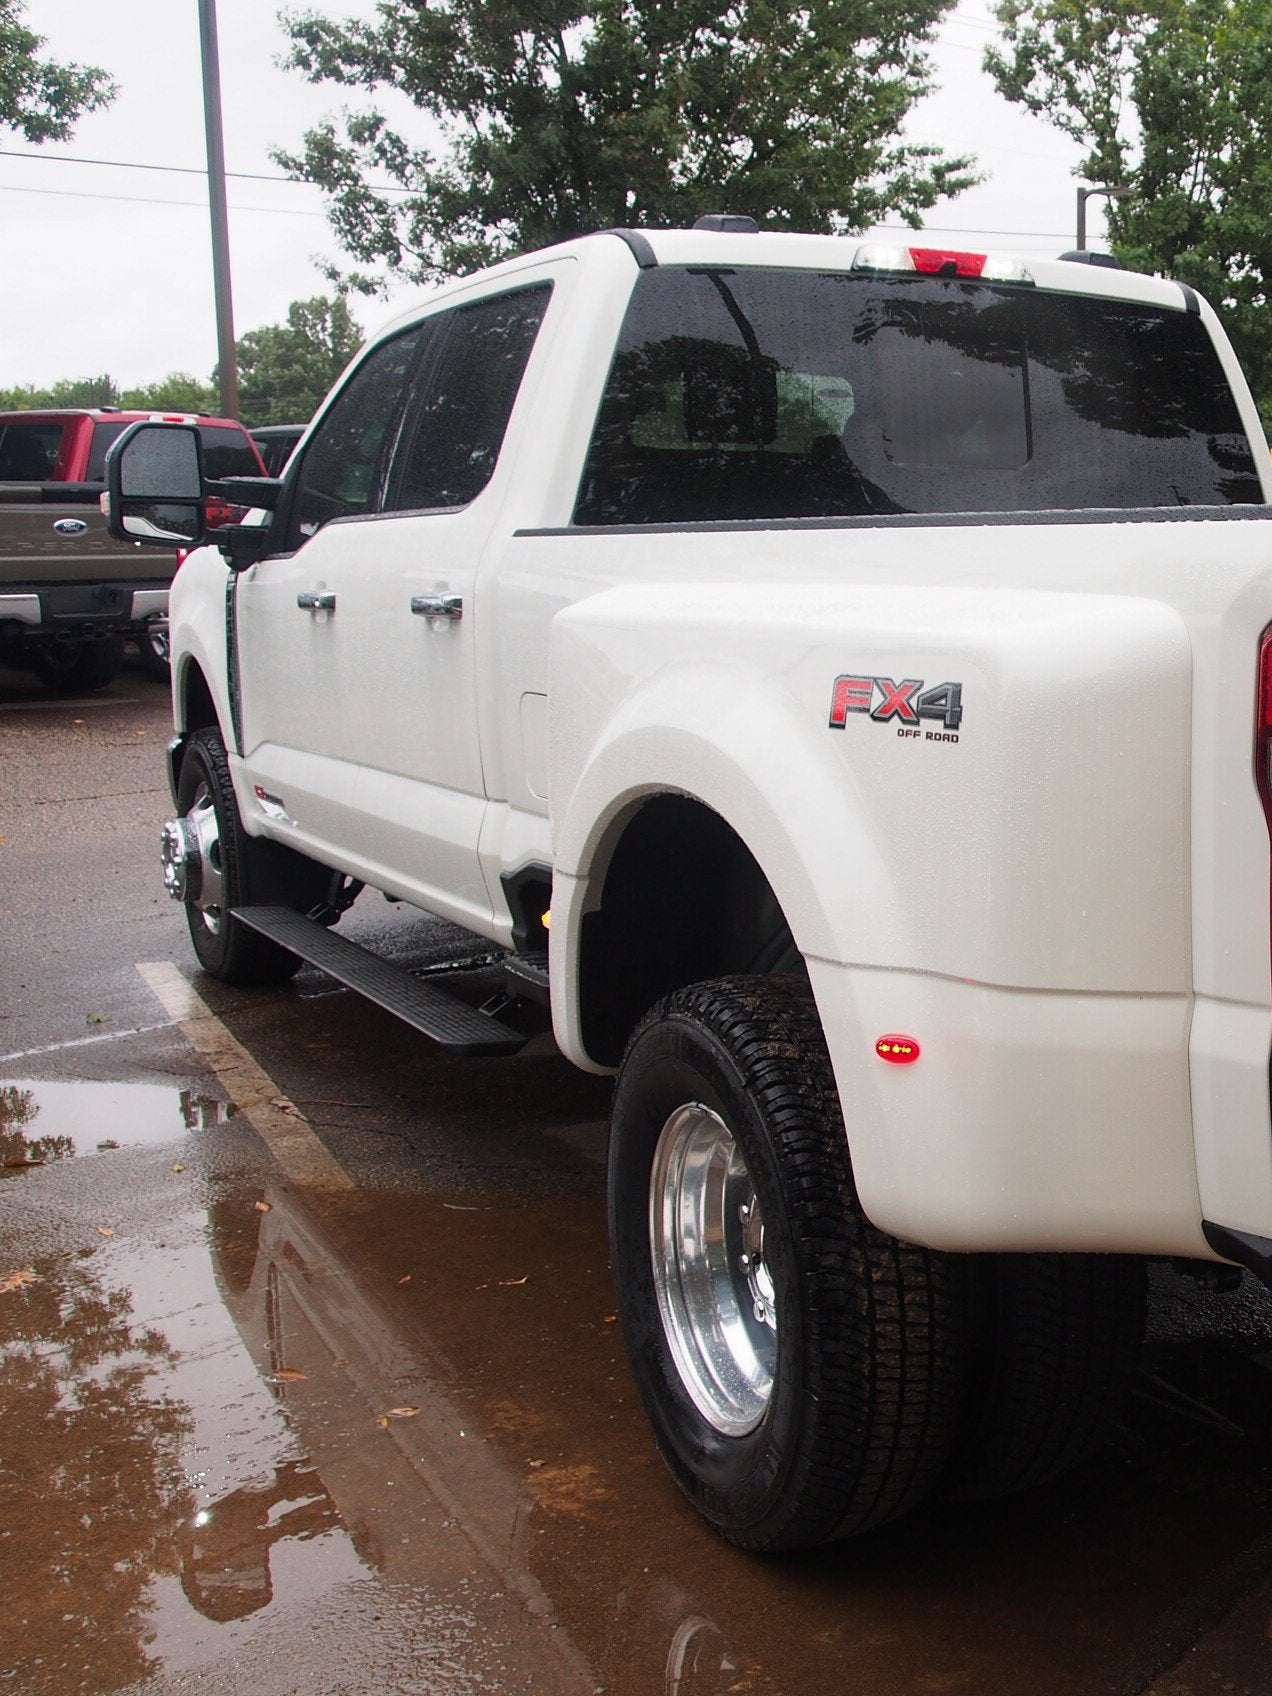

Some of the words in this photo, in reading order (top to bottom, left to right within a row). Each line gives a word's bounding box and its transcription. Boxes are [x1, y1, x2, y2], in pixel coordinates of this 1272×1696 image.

[829, 674, 963, 730] FX4
[897, 728, 921, 740] OFF
[925, 731, 960, 744] ROAD
